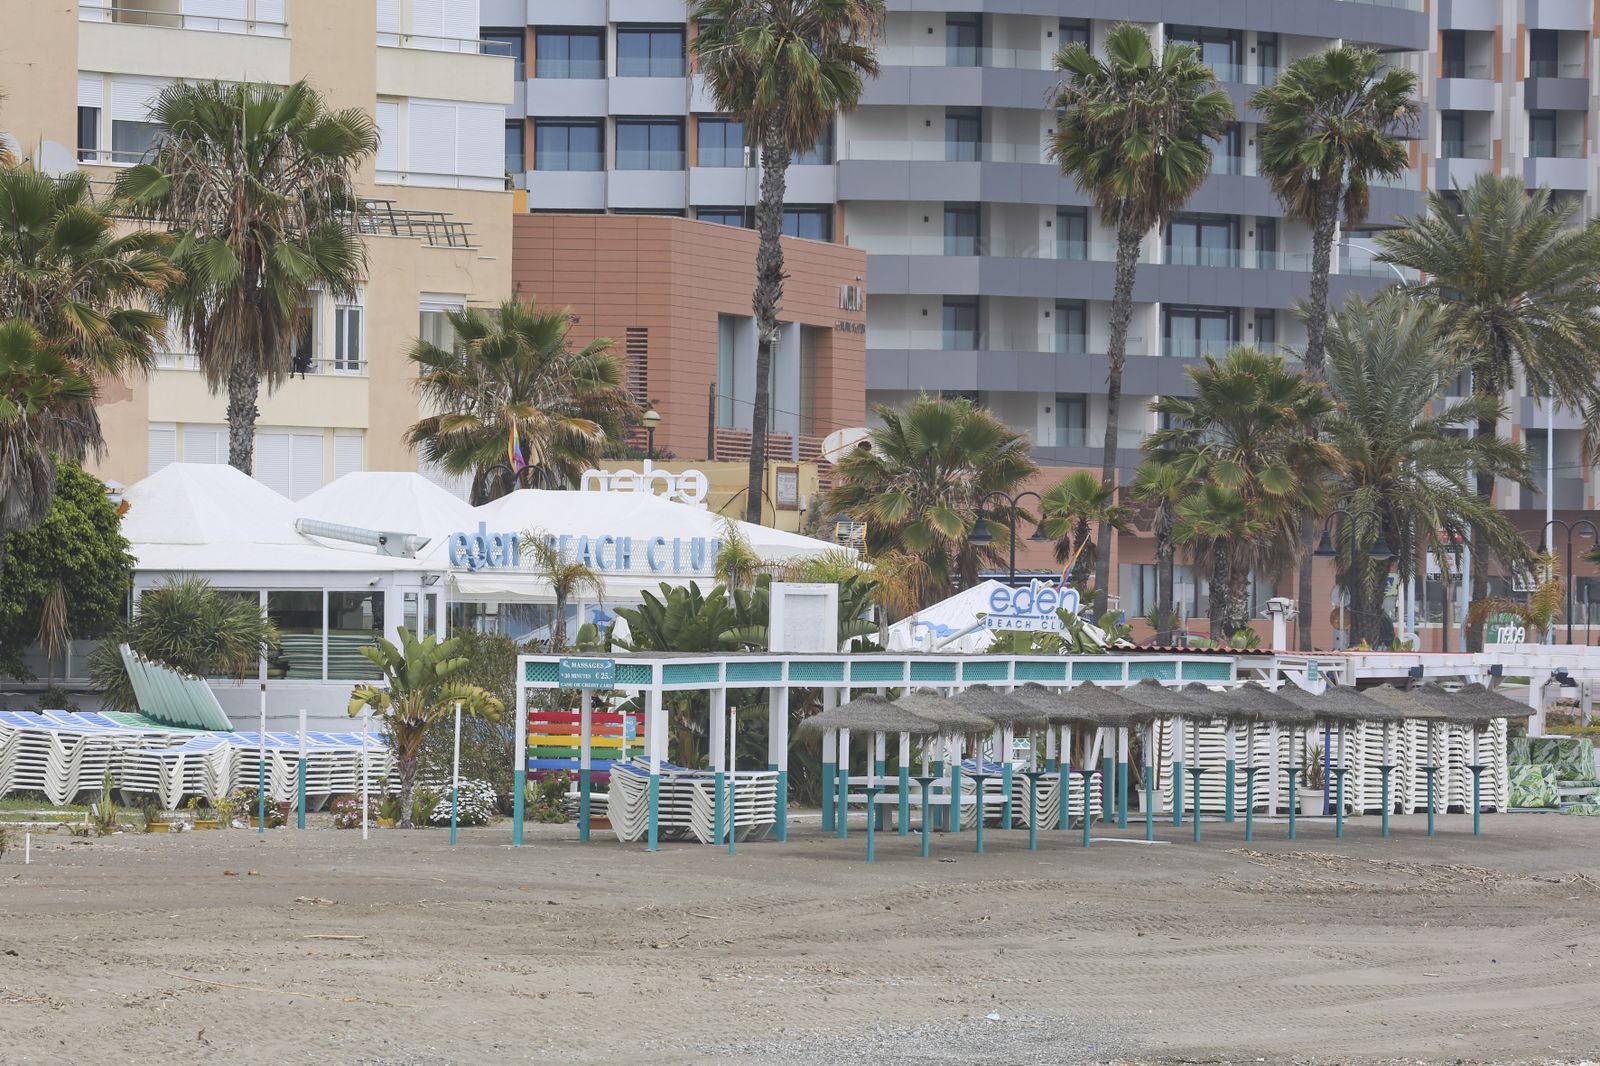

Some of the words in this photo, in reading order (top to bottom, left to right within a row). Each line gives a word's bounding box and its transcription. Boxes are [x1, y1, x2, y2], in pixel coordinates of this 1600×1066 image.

[449, 521, 520, 571] eden
[989, 578, 1079, 616] eden
[987, 618, 1032, 629] BEACH
[1041, 621, 1065, 630] CLU
